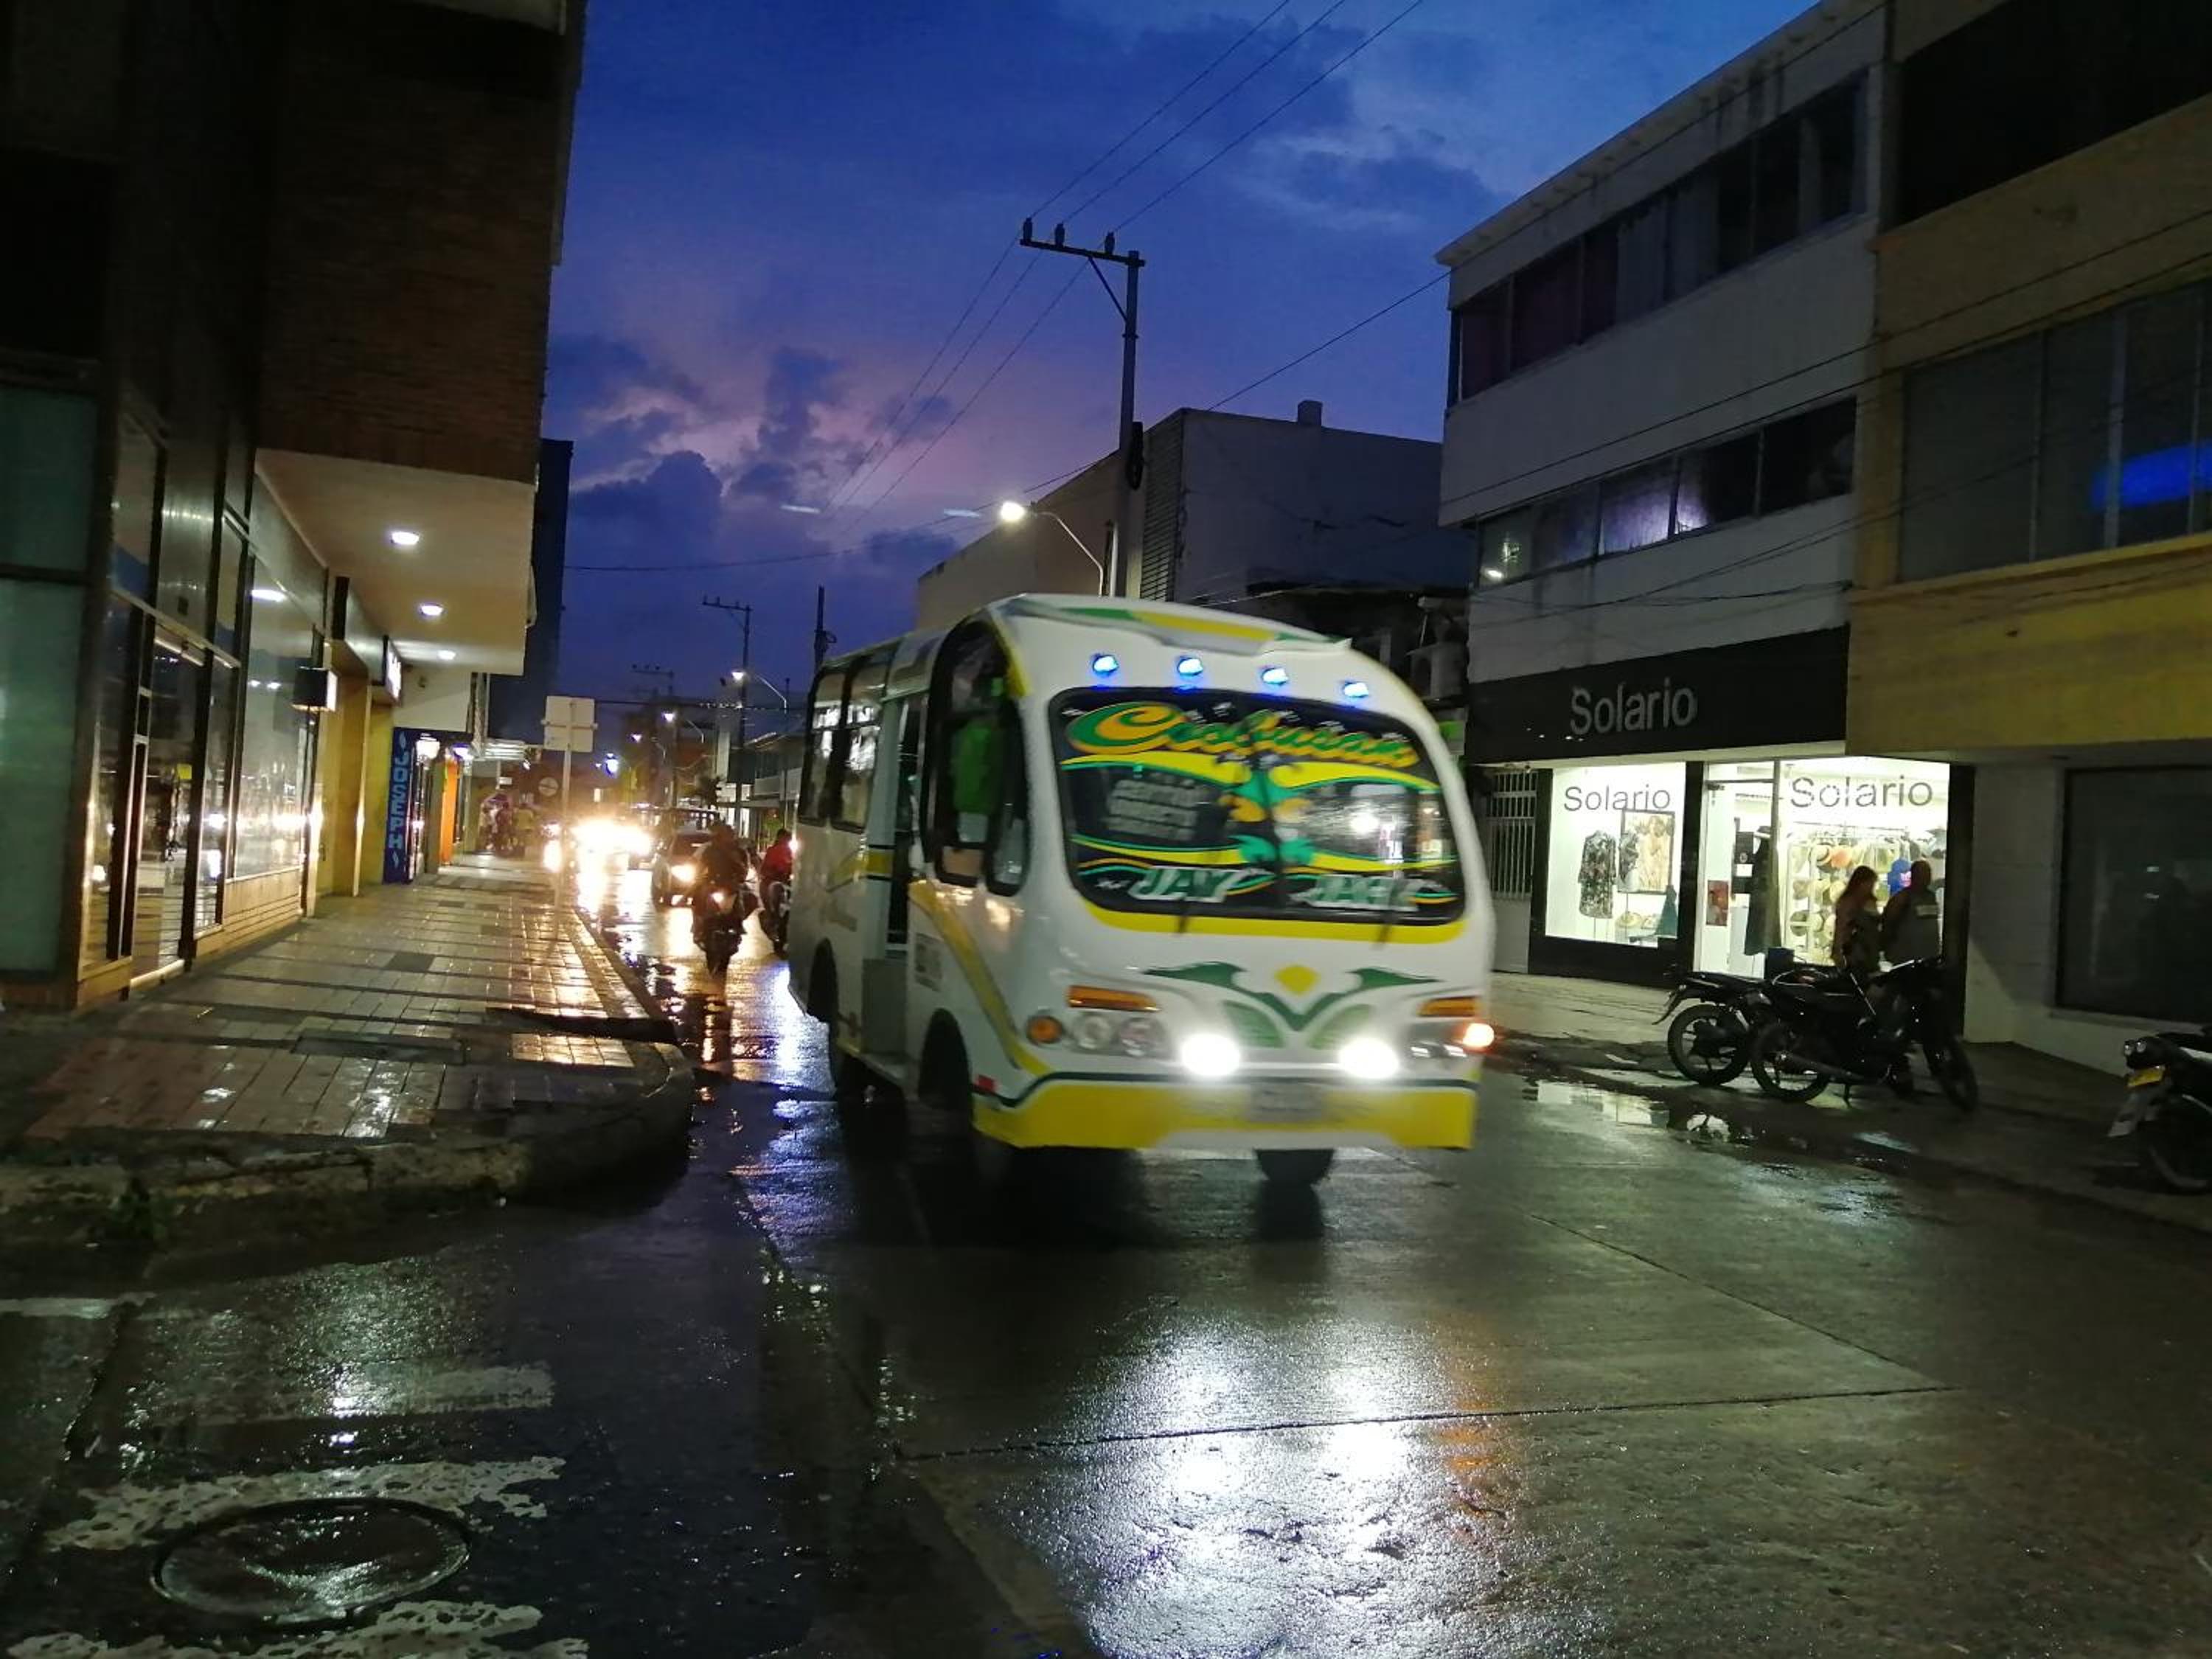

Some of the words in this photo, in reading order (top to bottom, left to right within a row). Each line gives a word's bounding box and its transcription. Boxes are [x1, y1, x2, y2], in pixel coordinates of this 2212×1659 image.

[1569, 676, 1697, 736] Solario
[389, 751, 408, 849] JOSEPH
[1564, 784, 1671, 812] Solario
[1791, 774, 1933, 808] Solario
